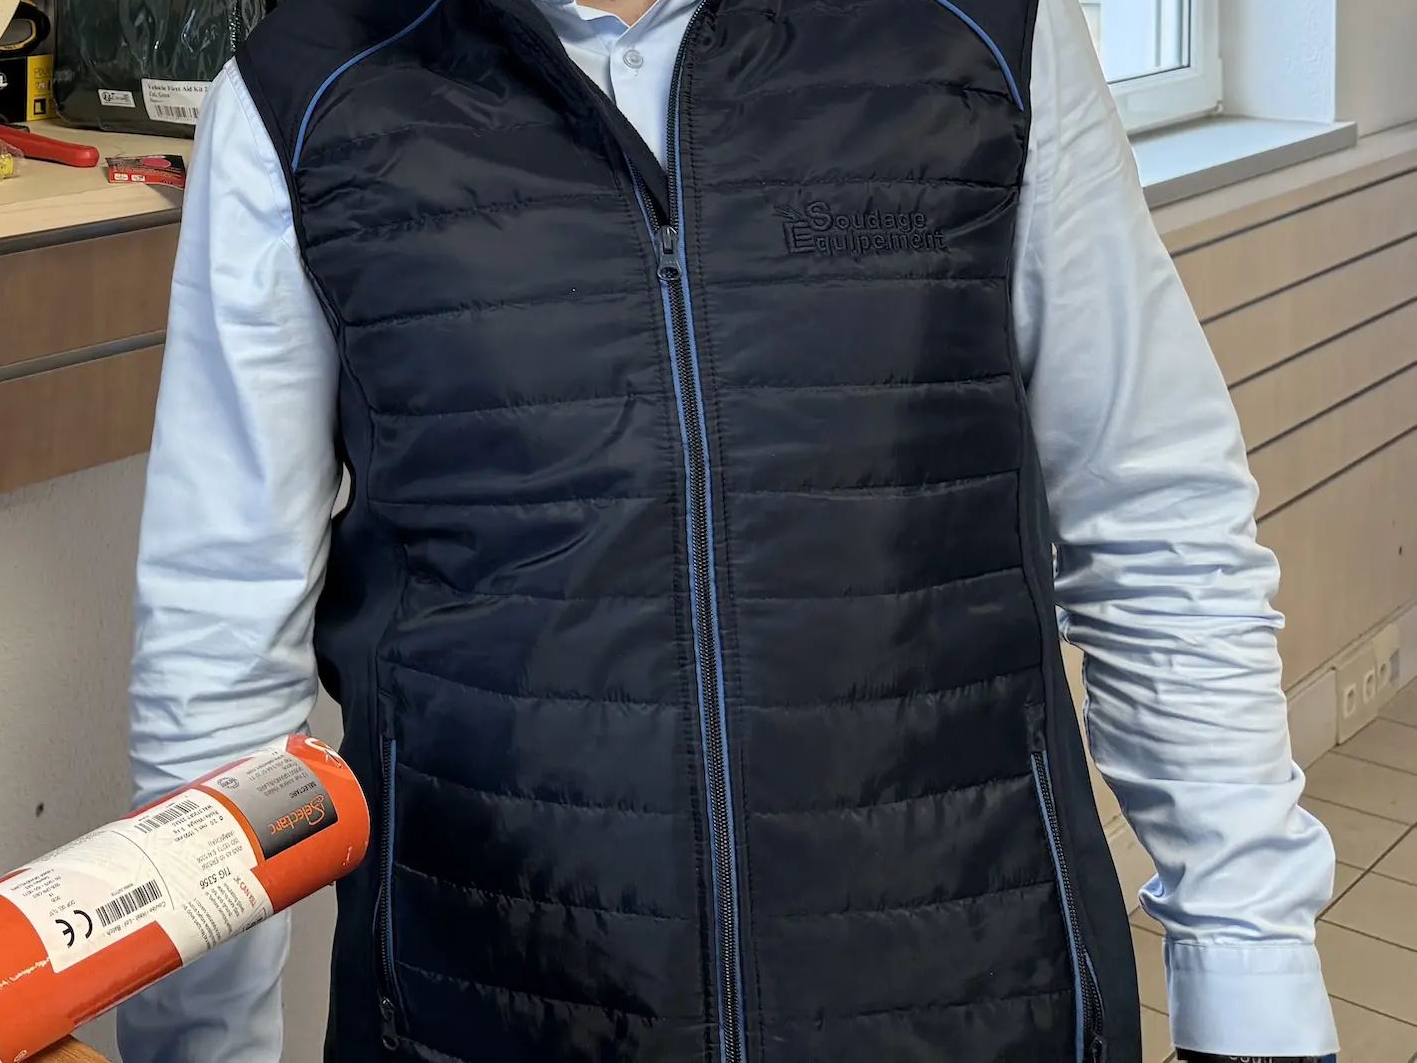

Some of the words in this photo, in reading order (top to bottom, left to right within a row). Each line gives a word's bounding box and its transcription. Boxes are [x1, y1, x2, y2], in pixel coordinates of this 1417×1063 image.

[804, 200, 927, 233] Soudage
[783, 221, 948, 256] Equipement
[287, 780, 316, 799] SELECTARC
[268, 803, 328, 846] Selectarc
[197, 872, 218, 889] 5356
[216, 865, 231, 879] TIG
